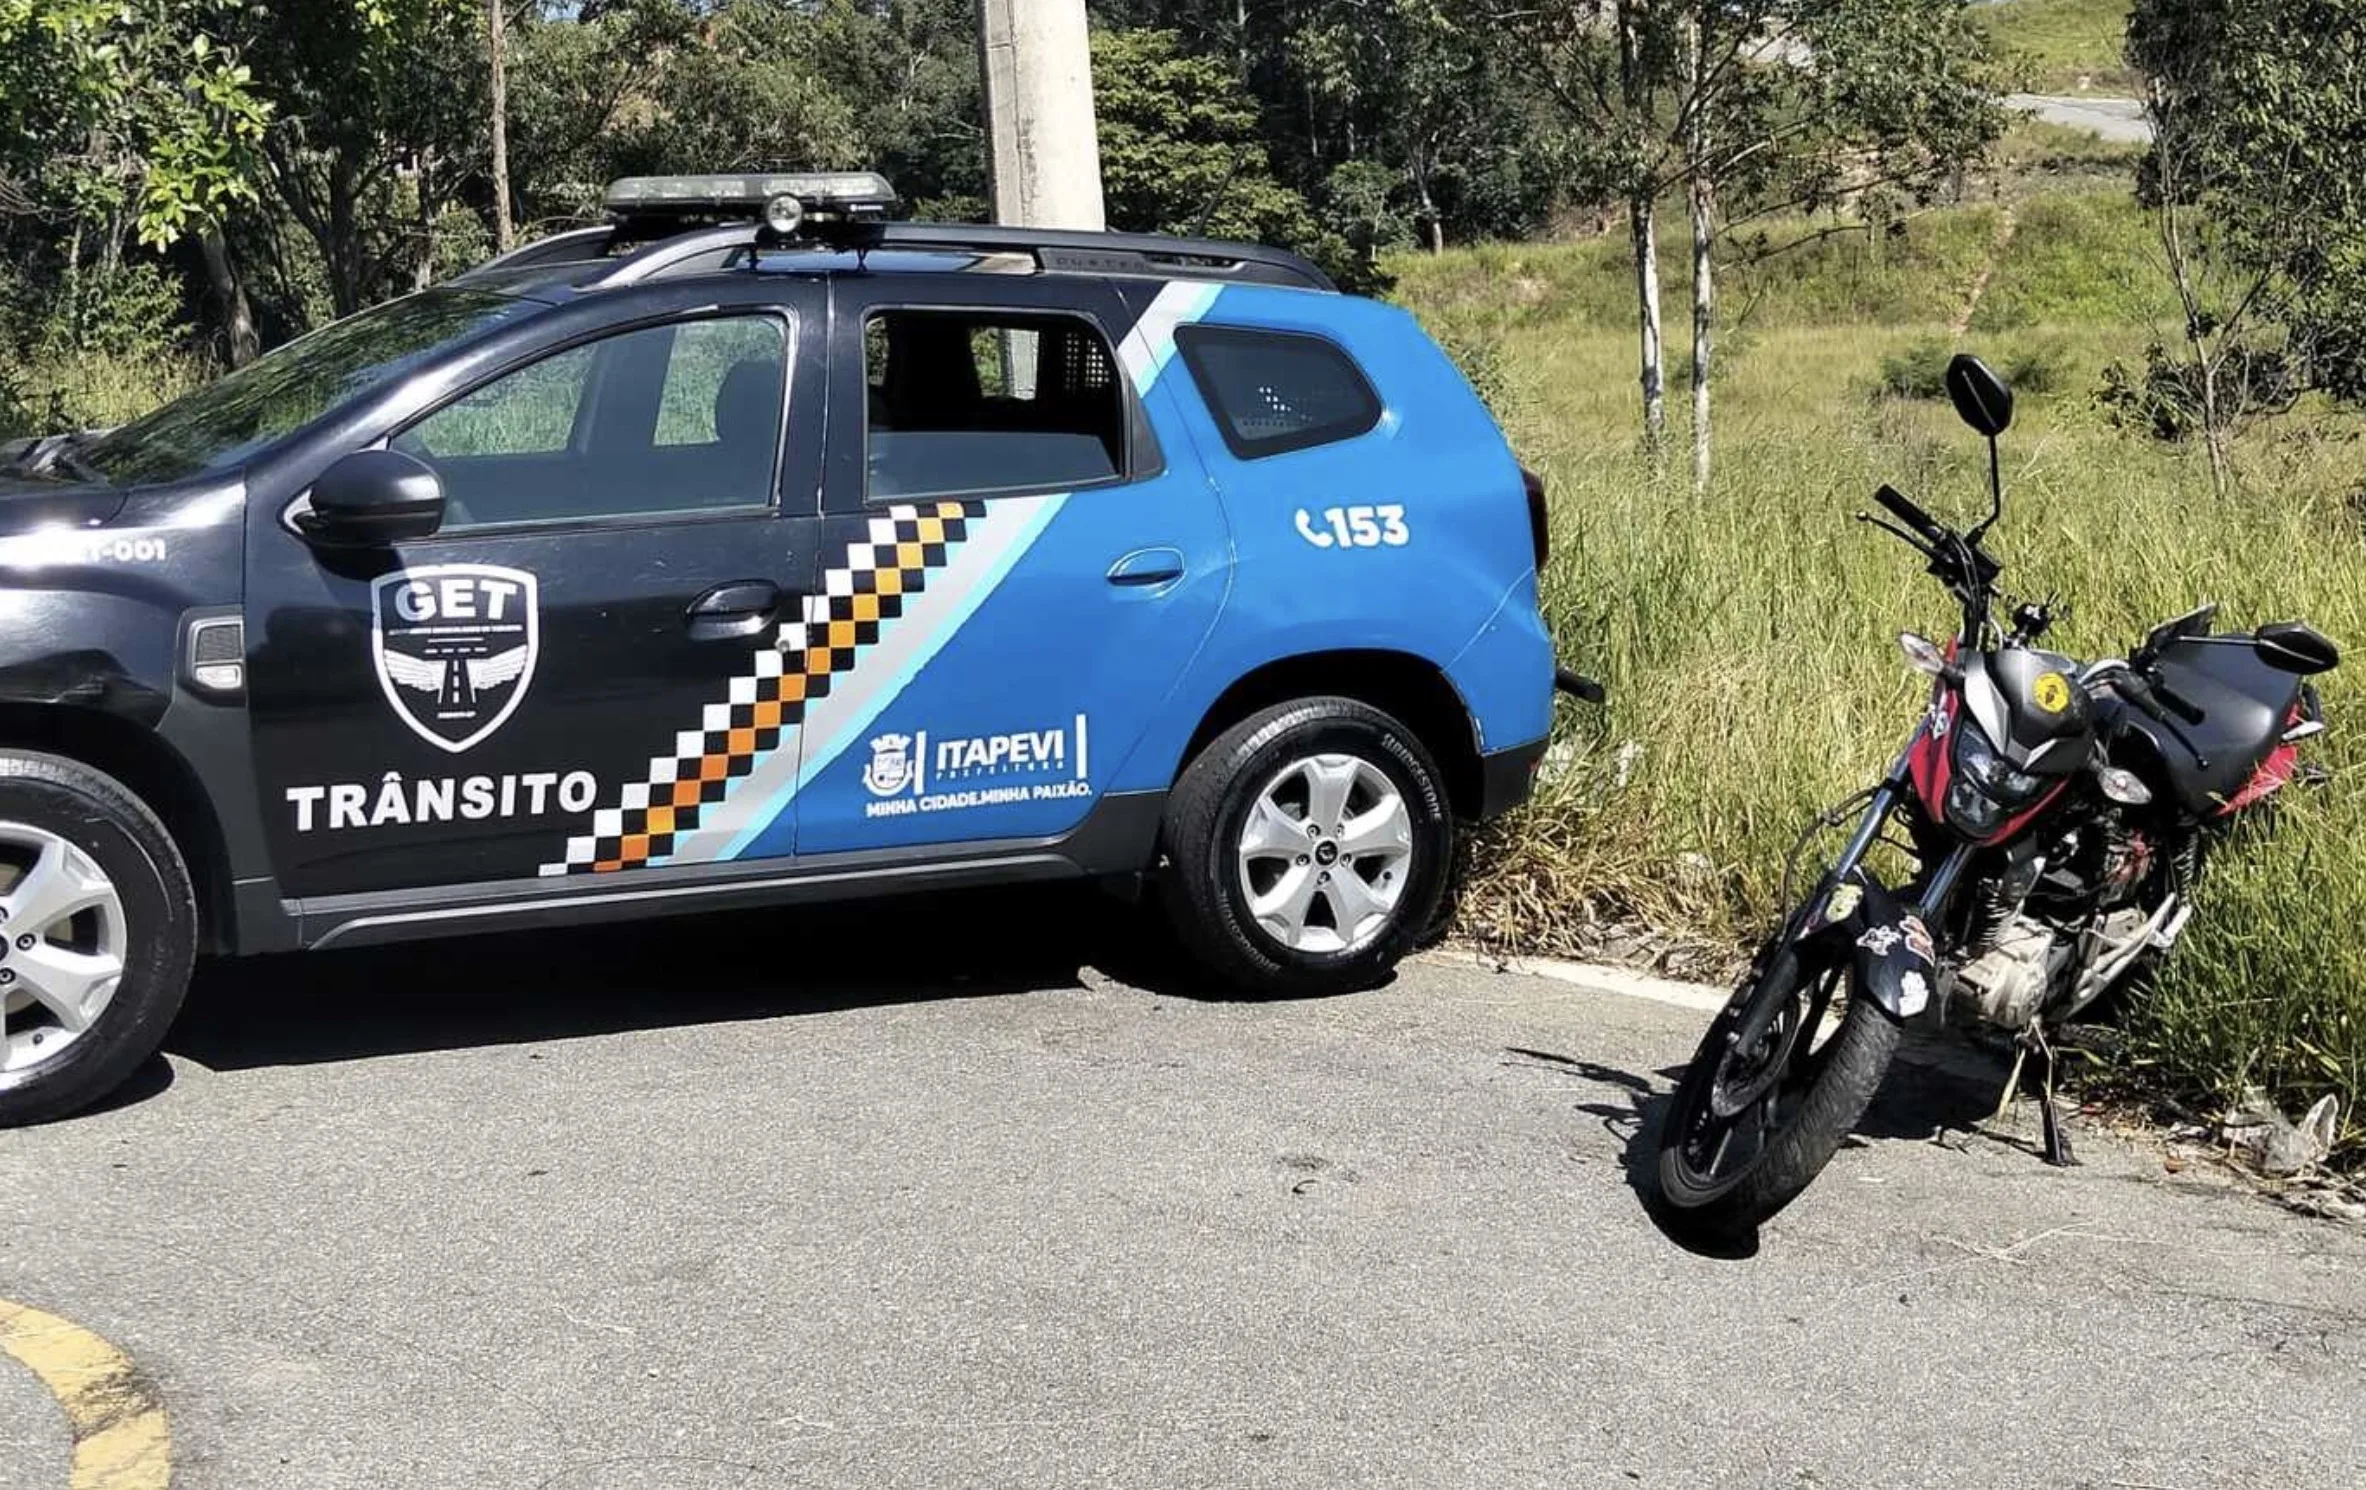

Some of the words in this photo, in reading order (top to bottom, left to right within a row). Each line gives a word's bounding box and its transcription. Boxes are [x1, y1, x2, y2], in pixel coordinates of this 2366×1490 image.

[1324, 504, 1409, 548] 153
[395, 580, 517, 622] GET
[936, 730, 1064, 770] ITAPEVI
[286, 771, 598, 831] TRÂNSITO
[866, 801, 918, 817] MINHA
[1033, 779, 1093, 800] PAIXÃO.
